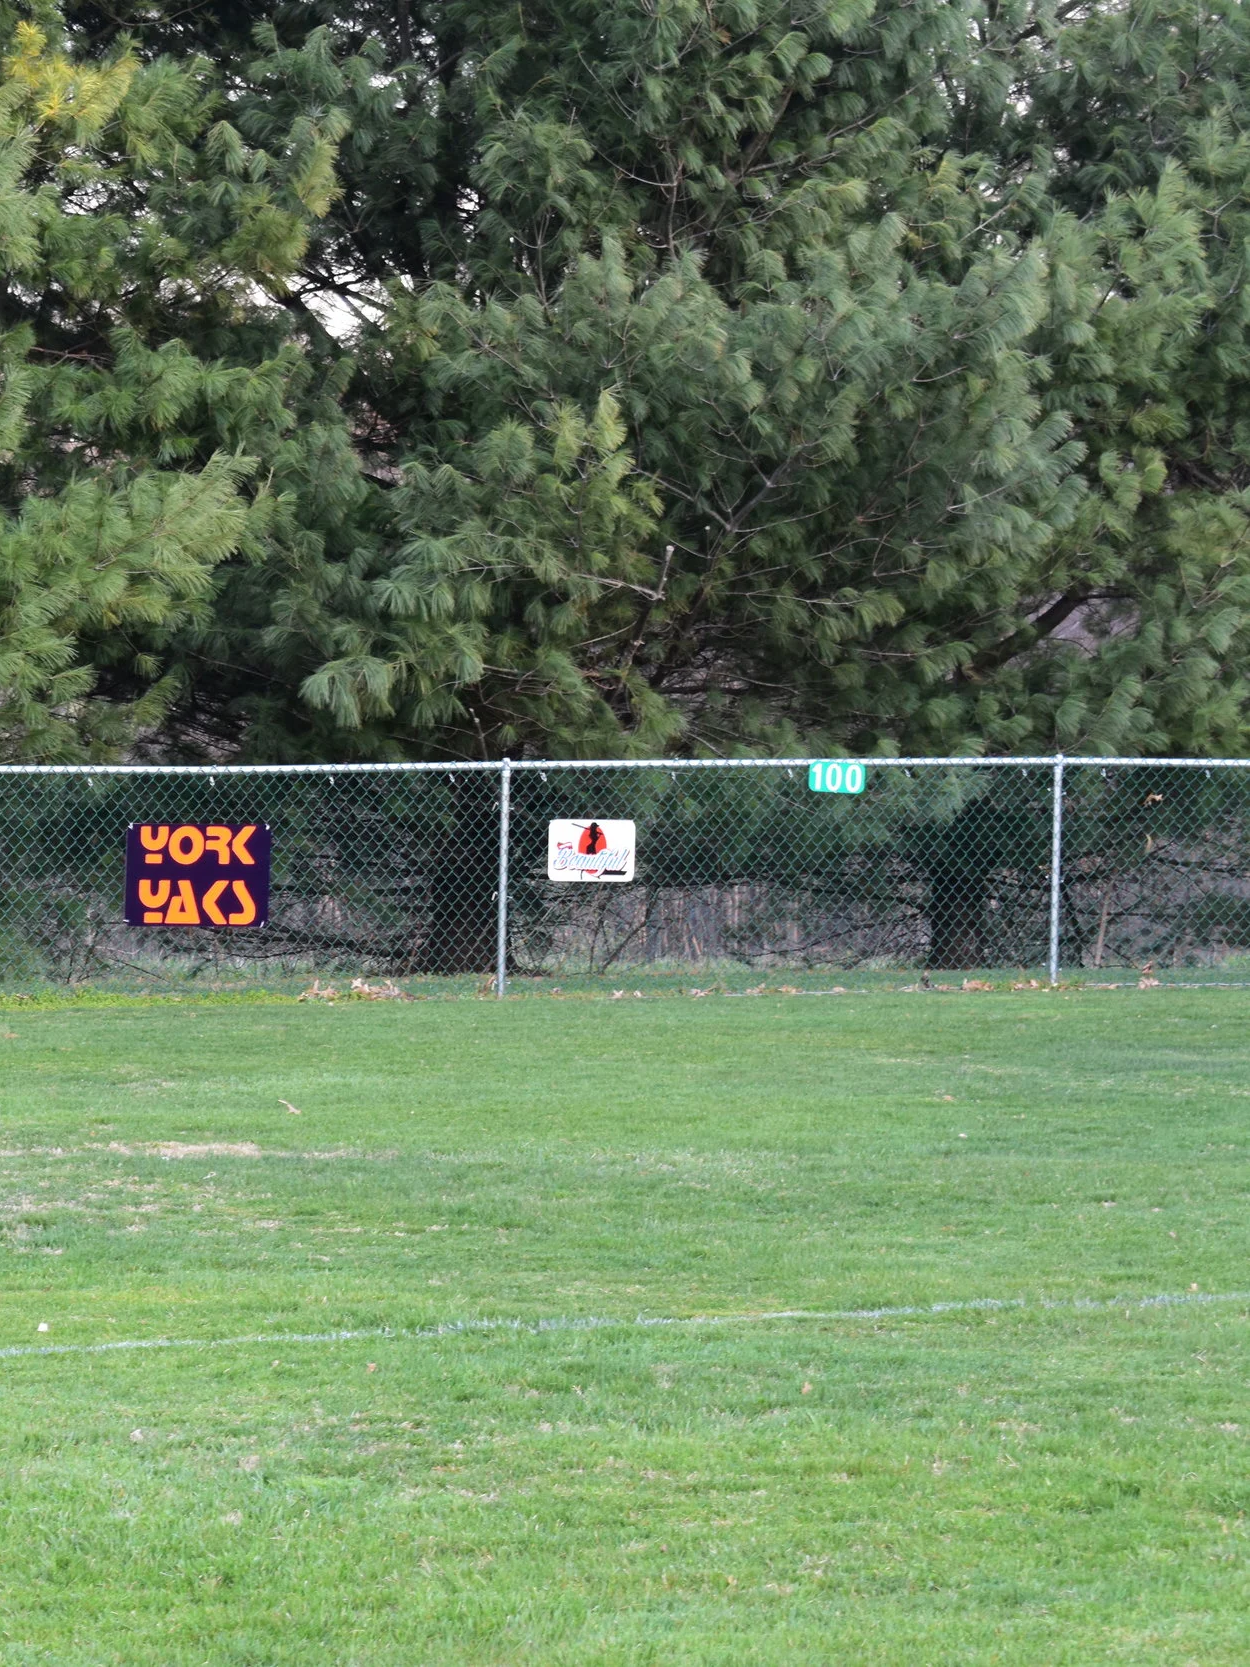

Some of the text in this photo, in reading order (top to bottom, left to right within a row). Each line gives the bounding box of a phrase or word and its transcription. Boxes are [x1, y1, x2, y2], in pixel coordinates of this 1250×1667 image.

[812, 762, 862, 793] 100
[140, 826, 257, 865] YORK
[138, 879, 256, 925] YAKS
